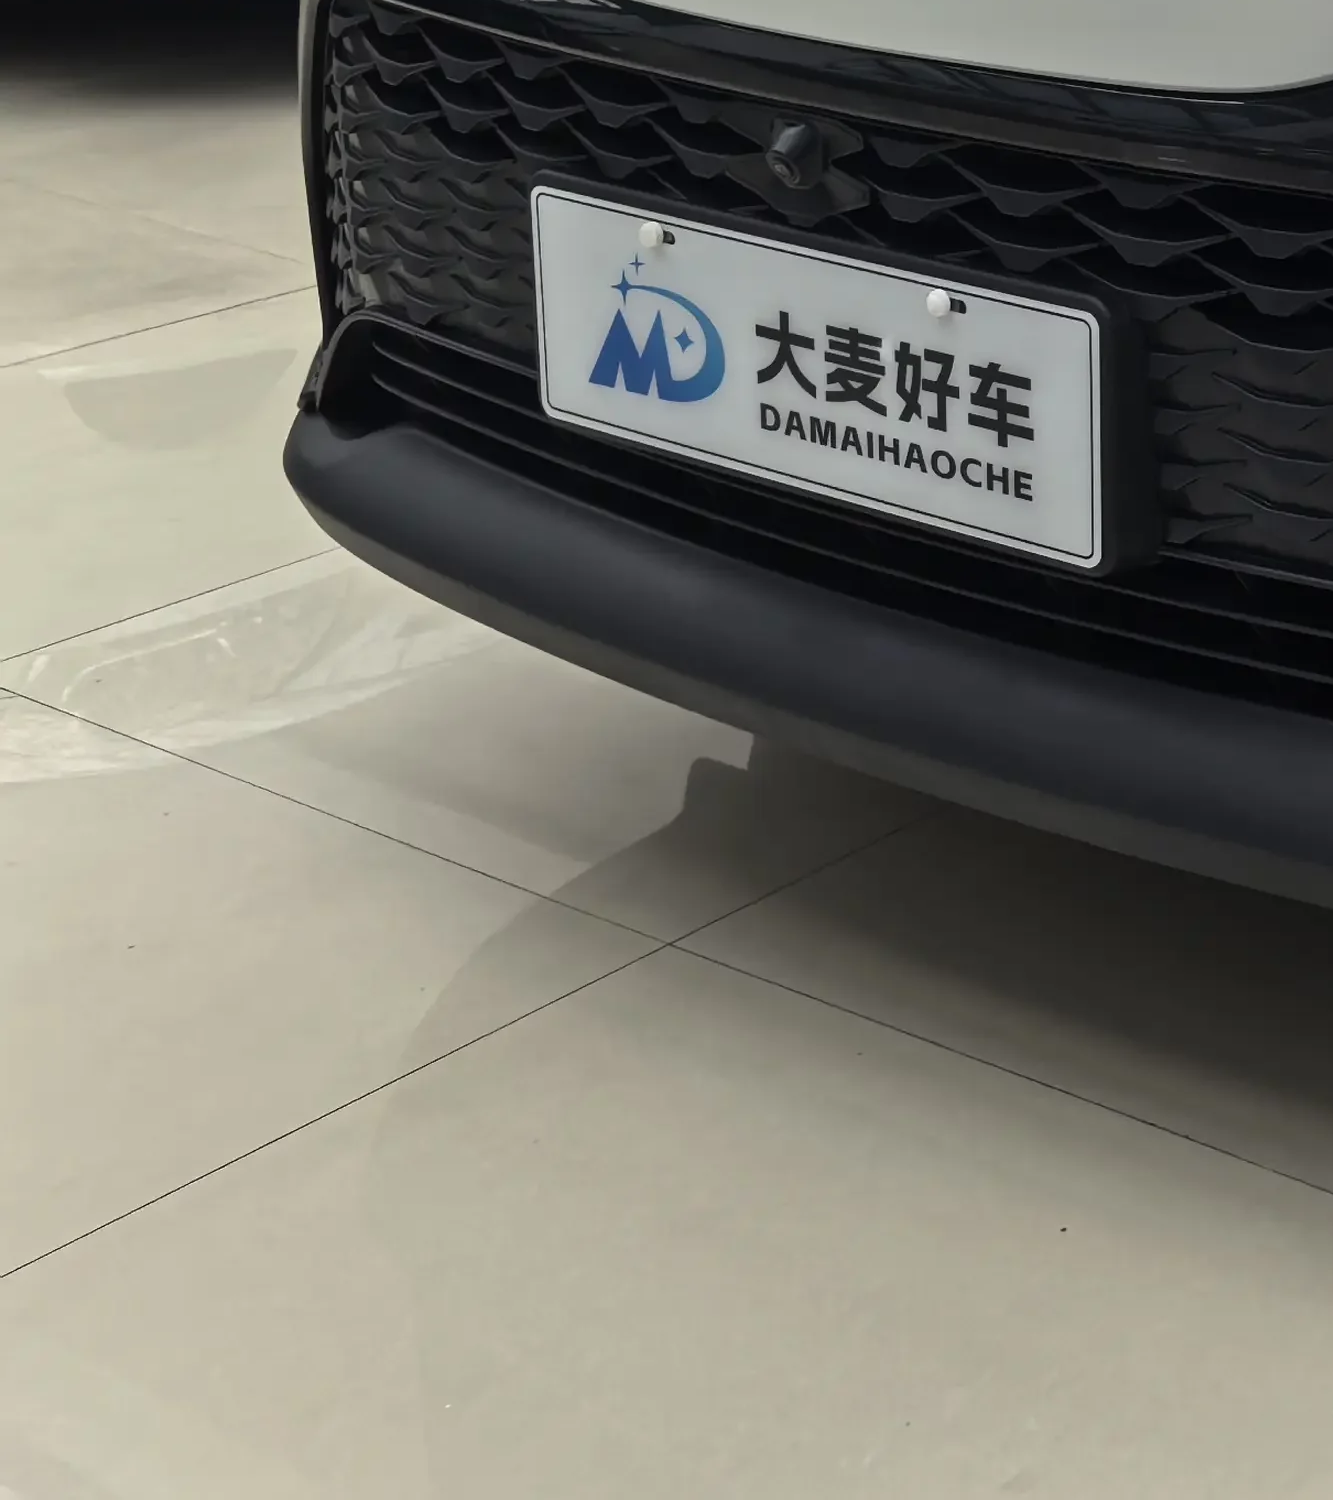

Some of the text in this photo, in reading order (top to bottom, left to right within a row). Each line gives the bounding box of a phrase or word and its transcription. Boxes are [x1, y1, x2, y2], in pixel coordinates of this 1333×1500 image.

[754, 310, 1035, 449] 大麦好车
[759, 402, 1034, 502] DAMAIHAOCHE
